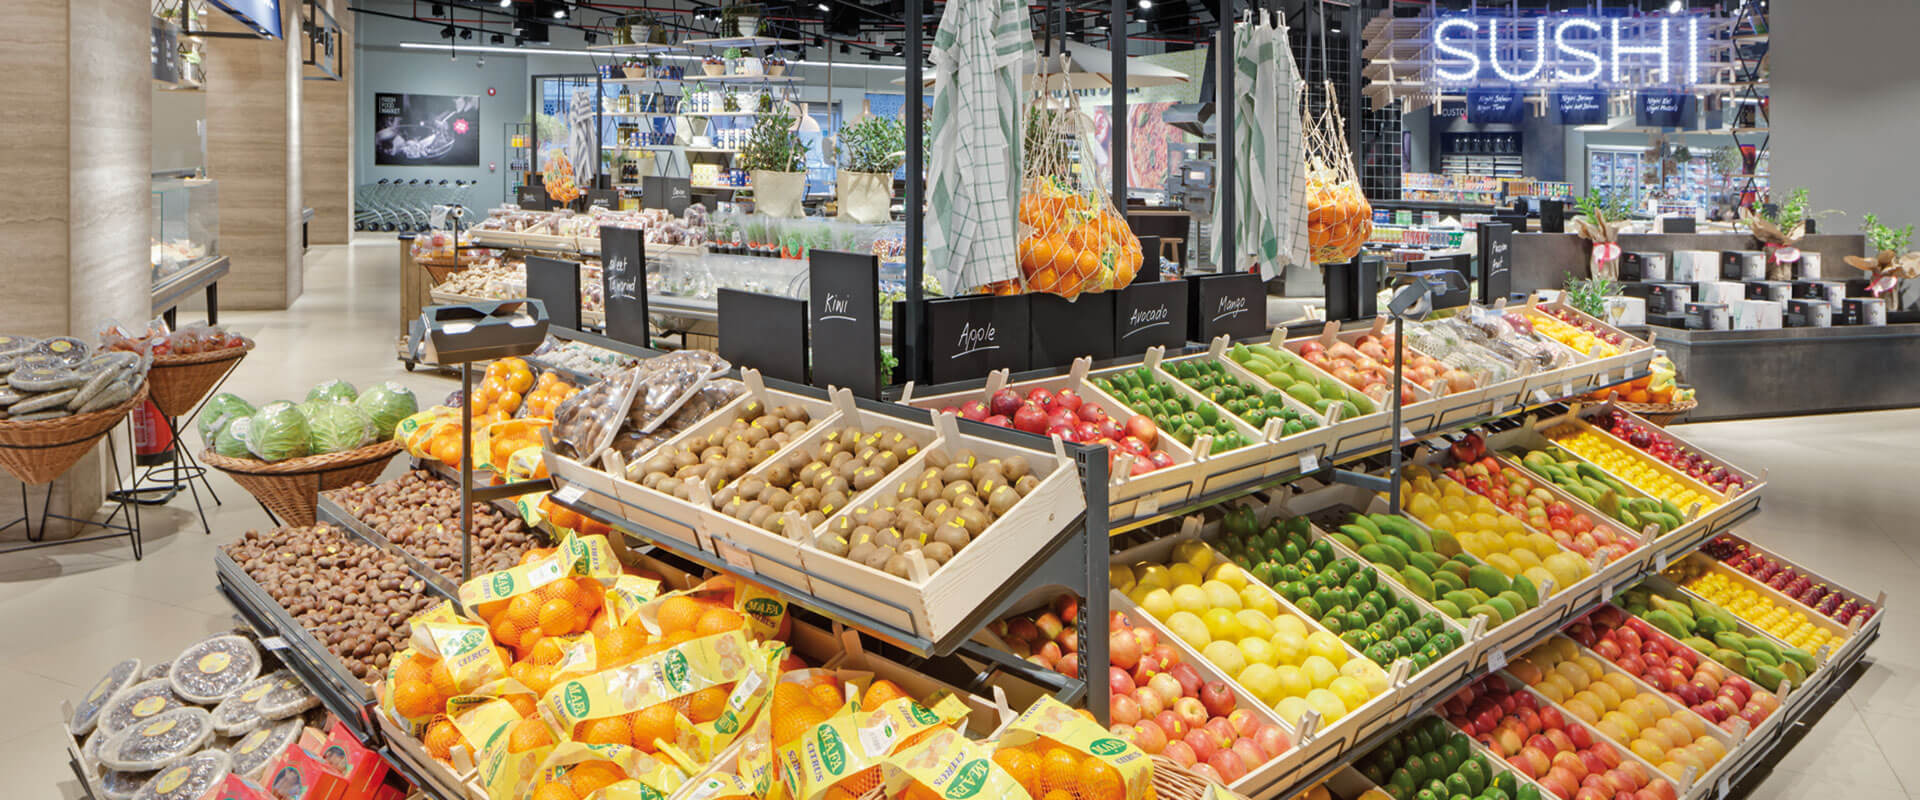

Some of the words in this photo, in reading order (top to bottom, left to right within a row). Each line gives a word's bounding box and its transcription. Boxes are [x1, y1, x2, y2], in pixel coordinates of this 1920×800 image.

[1434, 18, 1698, 83] SUSHI
[824, 292, 850, 313] Kiwi
[1130, 303, 1168, 325] Avocado
[1218, 295, 1246, 317] Mango
[958, 322, 996, 351] Apple
[745, 600, 779, 616] MAFA
[457, 647, 491, 668] CITRUS
[567, 683, 586, 715] MAFA
[820, 724, 844, 775] MAFA
[1092, 740, 1127, 755] MAFA
[806, 741, 825, 784] CITRUS
[933, 750, 965, 786] CITRUS
[946, 760, 989, 799] MAFA
